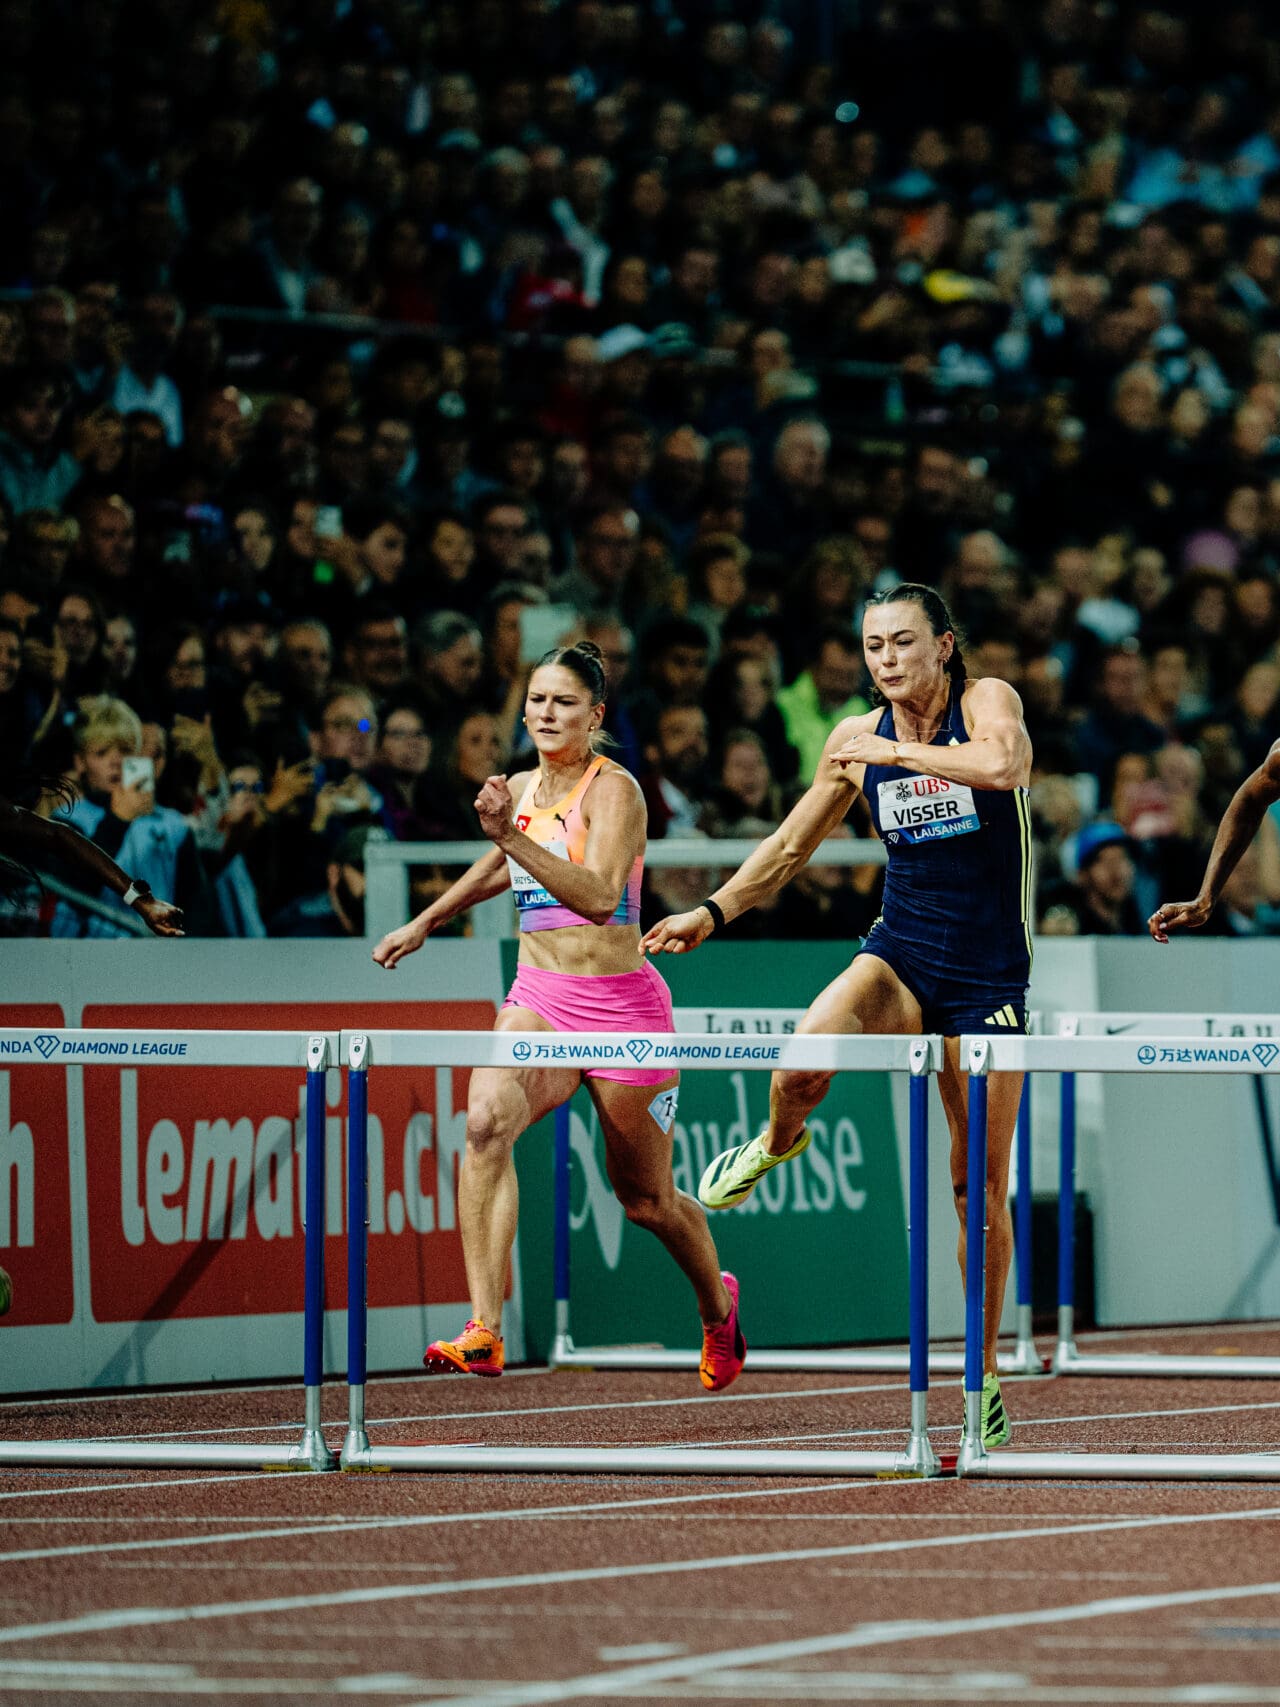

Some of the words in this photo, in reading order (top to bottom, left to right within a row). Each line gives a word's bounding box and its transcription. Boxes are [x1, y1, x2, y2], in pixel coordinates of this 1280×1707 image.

[913, 778, 951, 797] UBS
[893, 801, 960, 825] VISSER
[913, 820, 974, 840] LAUSANNE
[62, 1042, 129, 1055] DIAMOND
[132, 1043, 188, 1056] LEAGUE
[654, 1046, 721, 1059] DIAMOND
[724, 1047, 781, 1059] LEAGUE
